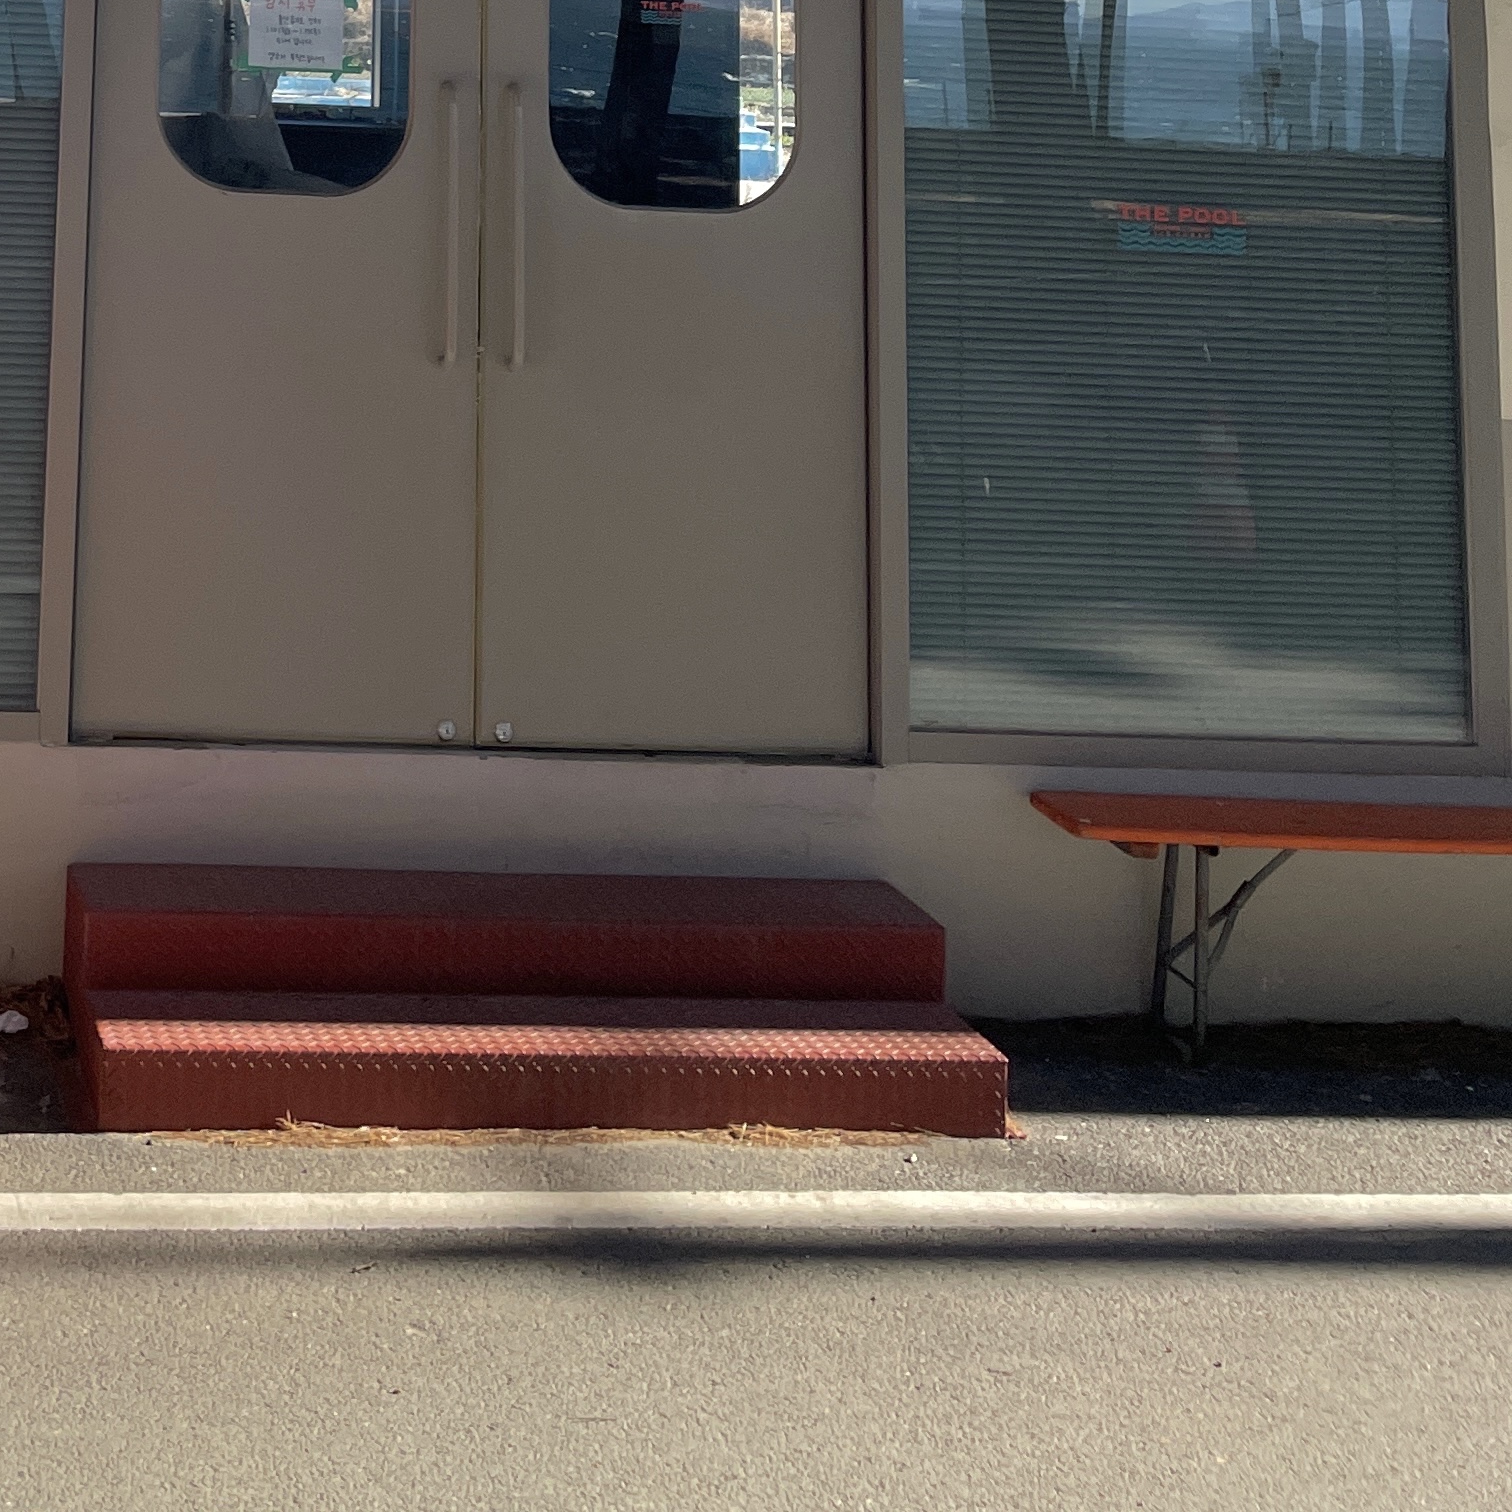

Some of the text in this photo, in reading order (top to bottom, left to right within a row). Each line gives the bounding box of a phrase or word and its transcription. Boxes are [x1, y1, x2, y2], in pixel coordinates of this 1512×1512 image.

[640, 1, 668, 10] THE
[1118, 203, 1247, 225] THE POOL
